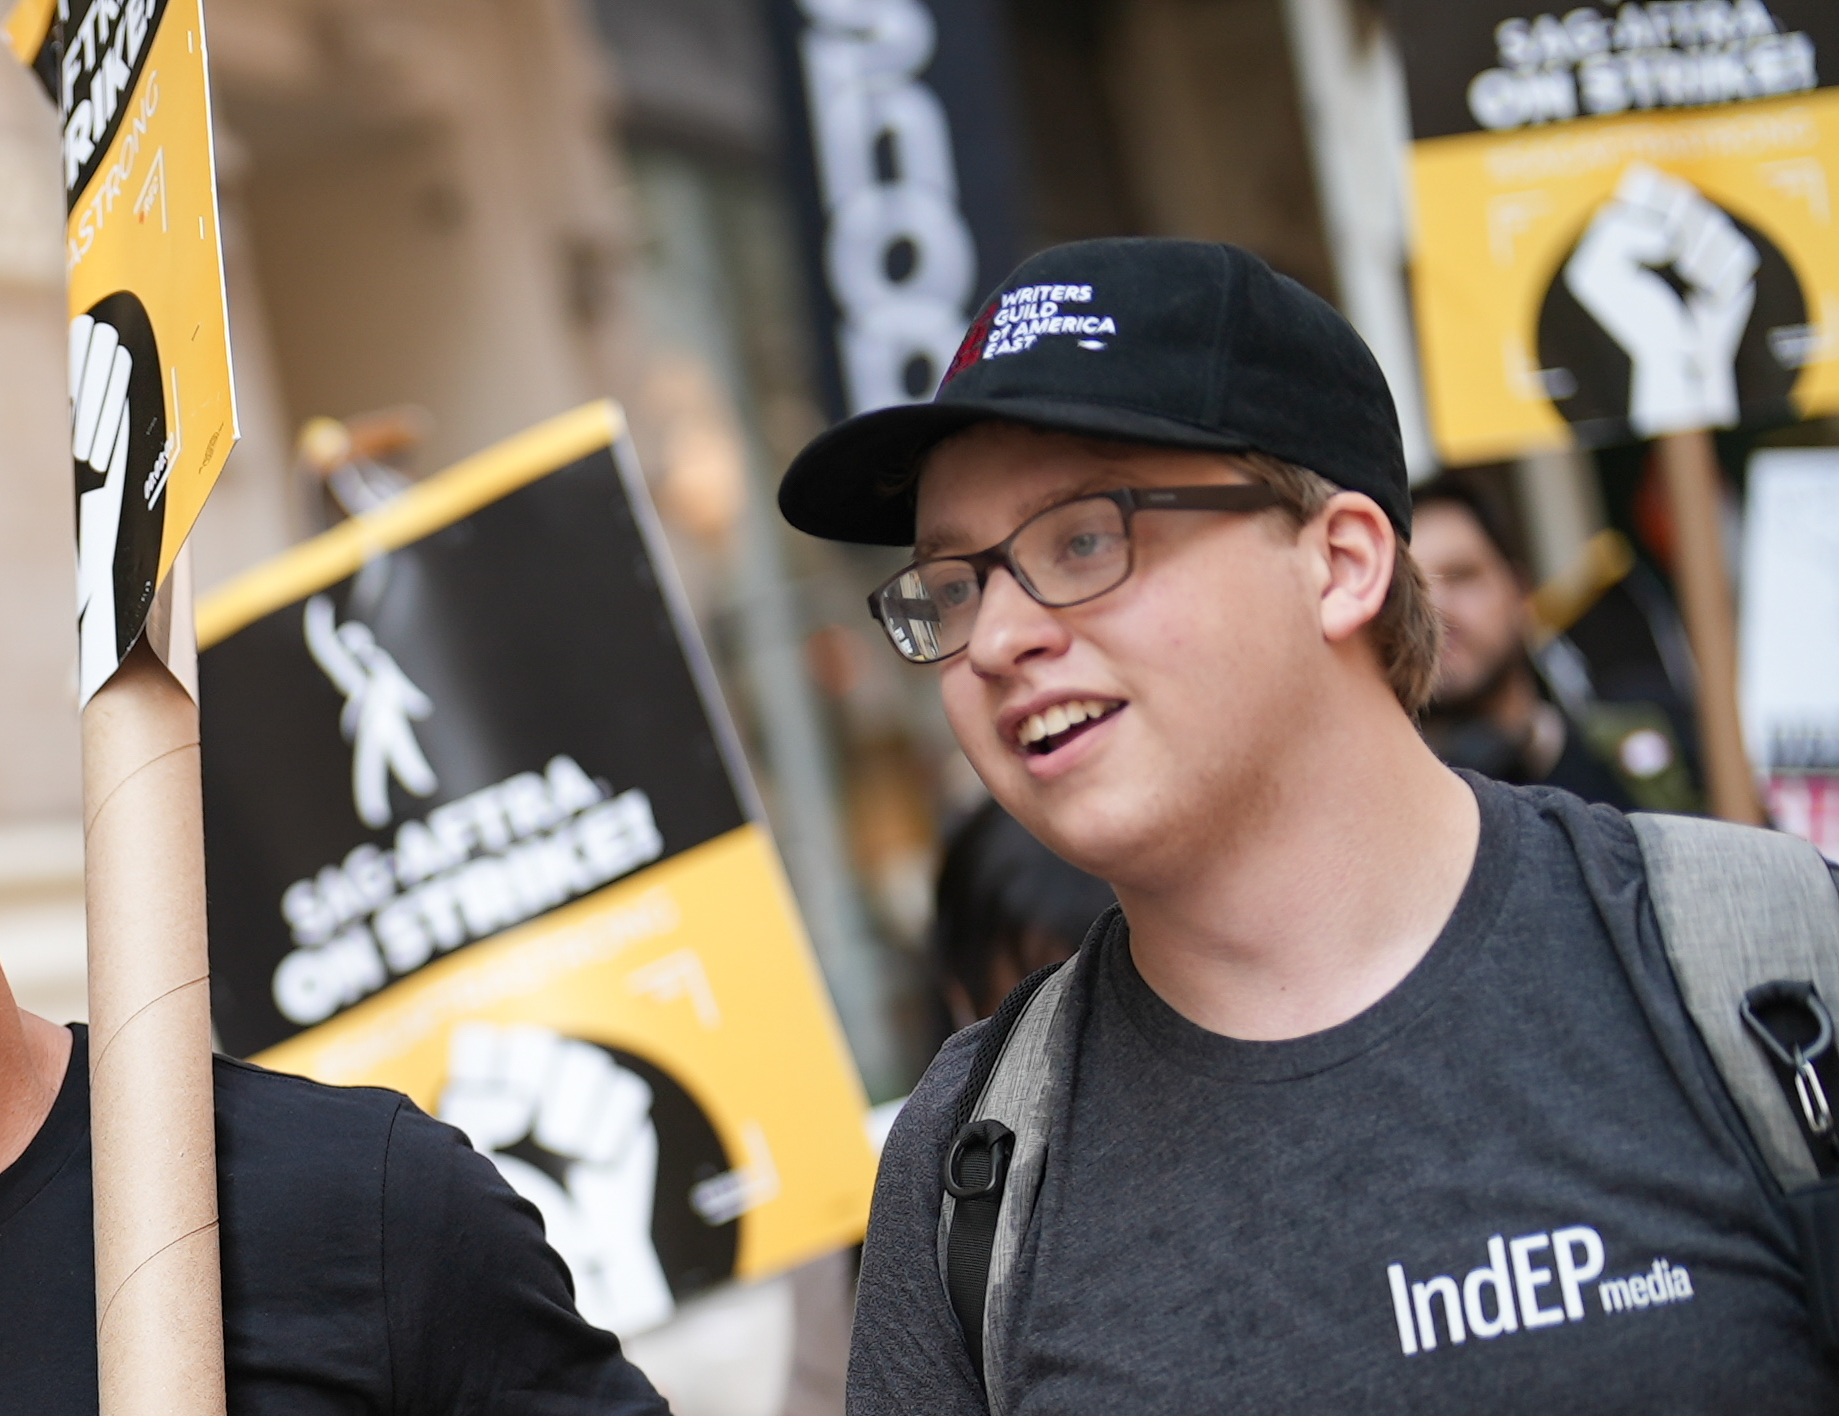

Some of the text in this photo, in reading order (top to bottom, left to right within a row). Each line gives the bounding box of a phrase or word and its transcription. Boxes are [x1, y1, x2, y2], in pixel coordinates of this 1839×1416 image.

[1001, 284, 1093, 309] WRITERS
[993, 301, 1059, 326] GUILD
[1012, 315, 1117, 339] AMERICA
[982, 335, 1038, 359] EAST
[272, 921, 388, 1026] ON
[372, 787, 663, 975] STRIKE!
[1386, 1224, 1694, 1356] IndEP media
